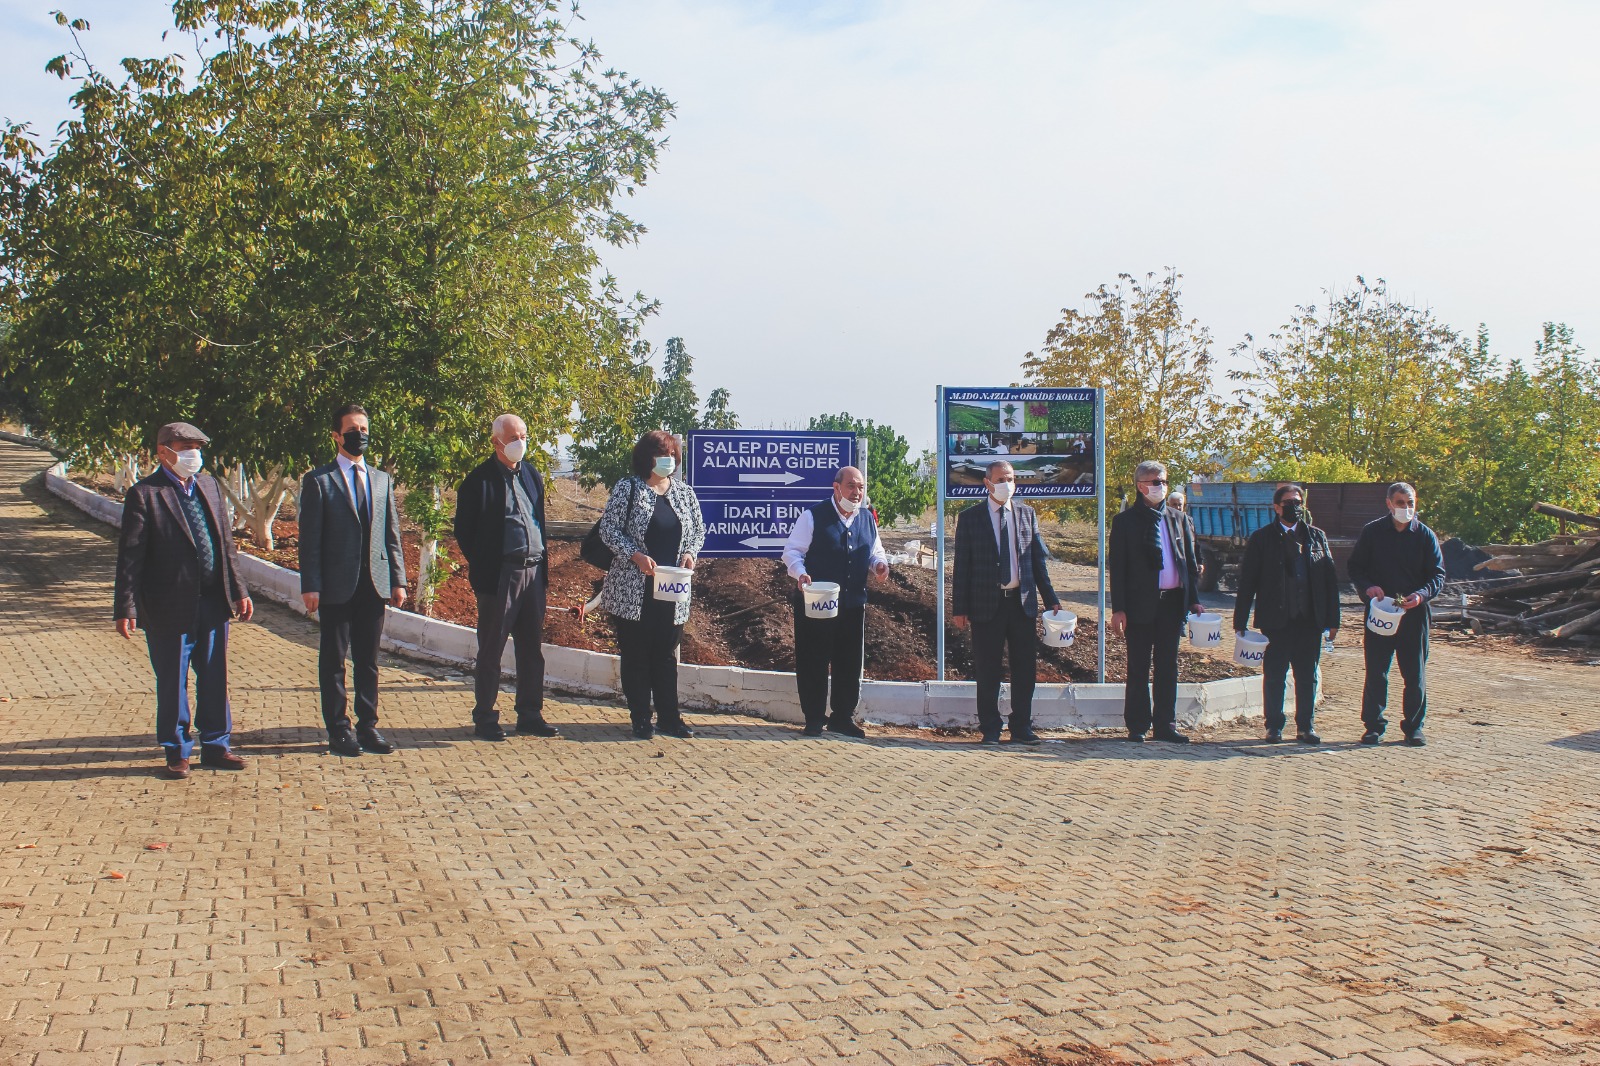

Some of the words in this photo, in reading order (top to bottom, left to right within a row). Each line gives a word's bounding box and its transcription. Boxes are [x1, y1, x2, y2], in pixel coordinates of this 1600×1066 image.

[950, 392, 979, 400] MADO
[980, 392, 1010, 400] NAZLI
[1020, 391, 1055, 400] ORKİDE
[703, 441, 762, 454] SALEP
[766, 443, 840, 454] DENEME
[702, 456, 781, 468] ALANINA
[723, 504, 771, 519] İDARİ
[776, 504, 805, 519] BİN
[1059, 630, 1074, 641] MA
[1207, 630, 1220, 641] MA
